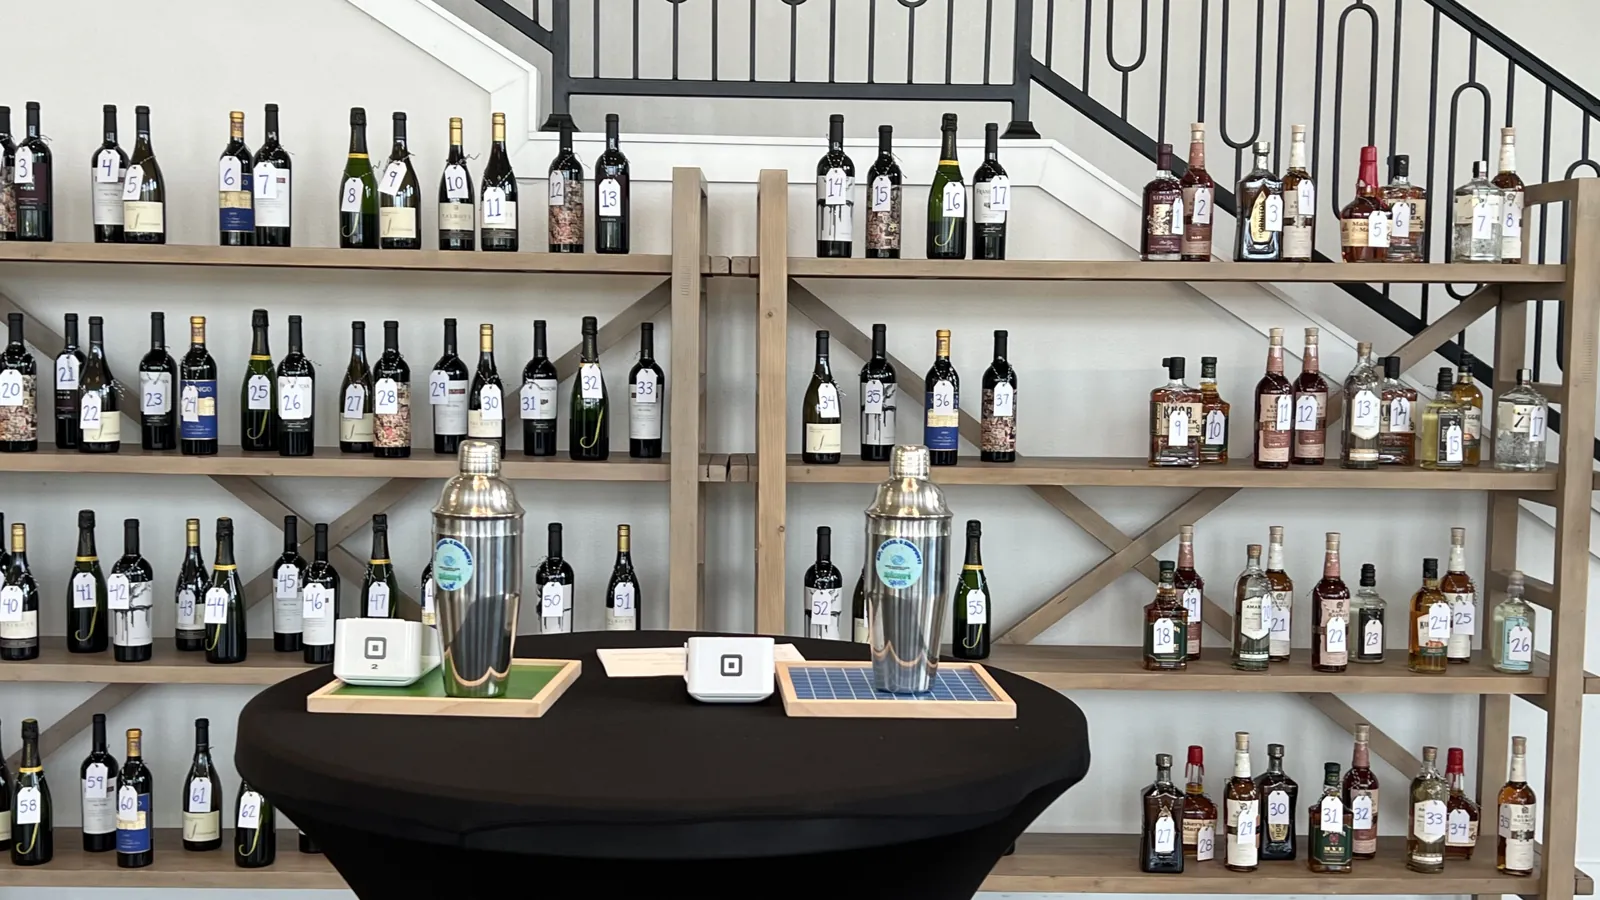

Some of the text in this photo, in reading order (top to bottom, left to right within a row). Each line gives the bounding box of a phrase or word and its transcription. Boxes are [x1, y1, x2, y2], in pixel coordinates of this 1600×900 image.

[19, 158, 28, 178] 3
[102, 159, 112, 177] 4
[126, 176, 137, 193] 5
[223, 168, 235, 186] 6
[258, 174, 270, 195] 7
[389, 171, 398, 188] 9
[447, 176, 463, 191] 10
[347, 187, 356, 203] 8
[550, 181, 563, 198] 12
[827, 177, 843, 198] 14
[874, 185, 888, 206] 15
[992, 185, 1007, 205] 17
[602, 190, 617, 208] 13
[945, 191, 960, 211] 16
[1302, 190, 1310, 205] 4
[486, 197, 501, 217] 11
[1197, 199, 1206, 216] 2
[1269, 204, 1279, 223] 3
[1174, 208, 1181, 230] 1
[1395, 212, 1403, 227] 6
[1477, 215, 1486, 232] 7
[1505, 213, 1513, 227] 8
[1373, 222, 1382, 238] 5
[58, 366, 75, 382] 21
[2, 382, 20, 399] 20
[430, 381, 446, 398] 29
[583, 375, 599, 391] 32
[637, 380, 653, 395] 33
[145, 392, 163, 407] 23
[250, 385, 268, 401] 25
[377, 390, 396, 406] 28
[866, 389, 881, 404] 35
[935, 393, 950, 408] 36
[995, 393, 1010, 407] 37
[184, 396, 196, 414] 24
[283, 394, 301, 411] 26
[346, 396, 361, 411] 27
[483, 395, 499, 411] 30
[522, 396, 536, 411] 31
[821, 395, 835, 410] 34
[1356, 400, 1371, 419] 13
[83, 405, 99, 421] 22
[1279, 403, 1289, 423] 11
[1297, 405, 1313, 423] 12
[580, 406, 604, 449] J
[1175, 420, 1181, 437] 9
[1208, 420, 1221, 440] 10
[1532, 416, 1543, 437] 17
[1449, 435, 1460, 455] 15
[279, 574, 295, 592] 45
[76, 584, 93, 601] 41
[110, 584, 127, 601] 42
[616, 592, 632, 609] 51
[3, 598, 18, 614] 40
[180, 601, 193, 617] 43
[207, 597, 225, 617] 44
[305, 594, 322, 611] 46
[370, 593, 386, 611] 47
[544, 594, 561, 608] 50
[813, 601, 828, 616] 52
[968, 600, 984, 615] 55
[1185, 597, 1197, 617] 19
[1271, 617, 1287, 632] 21
[1430, 615, 1448, 630] 24
[1455, 612, 1472, 625] 25
[1156, 627, 1171, 646] 18
[1328, 628, 1343, 644] 22
[1366, 631, 1379, 646] 23
[1511, 637, 1530, 653] 26
[87, 776, 103, 791] 59
[120, 796, 133, 811] 60
[192, 787, 206, 804] 61
[19, 798, 37, 813] 58
[241, 803, 256, 818] 62
[1270, 802, 1287, 816] 30
[1323, 807, 1339, 824] 31
[1354, 807, 1369, 821] 32
[1426, 812, 1443, 825] 33
[1499, 815, 1510, 829] 35
[1157, 828, 1171, 843] 27
[1240, 821, 1253, 836] 29
[1450, 823, 1467, 837] 34
[1199, 838, 1213, 854] 28
